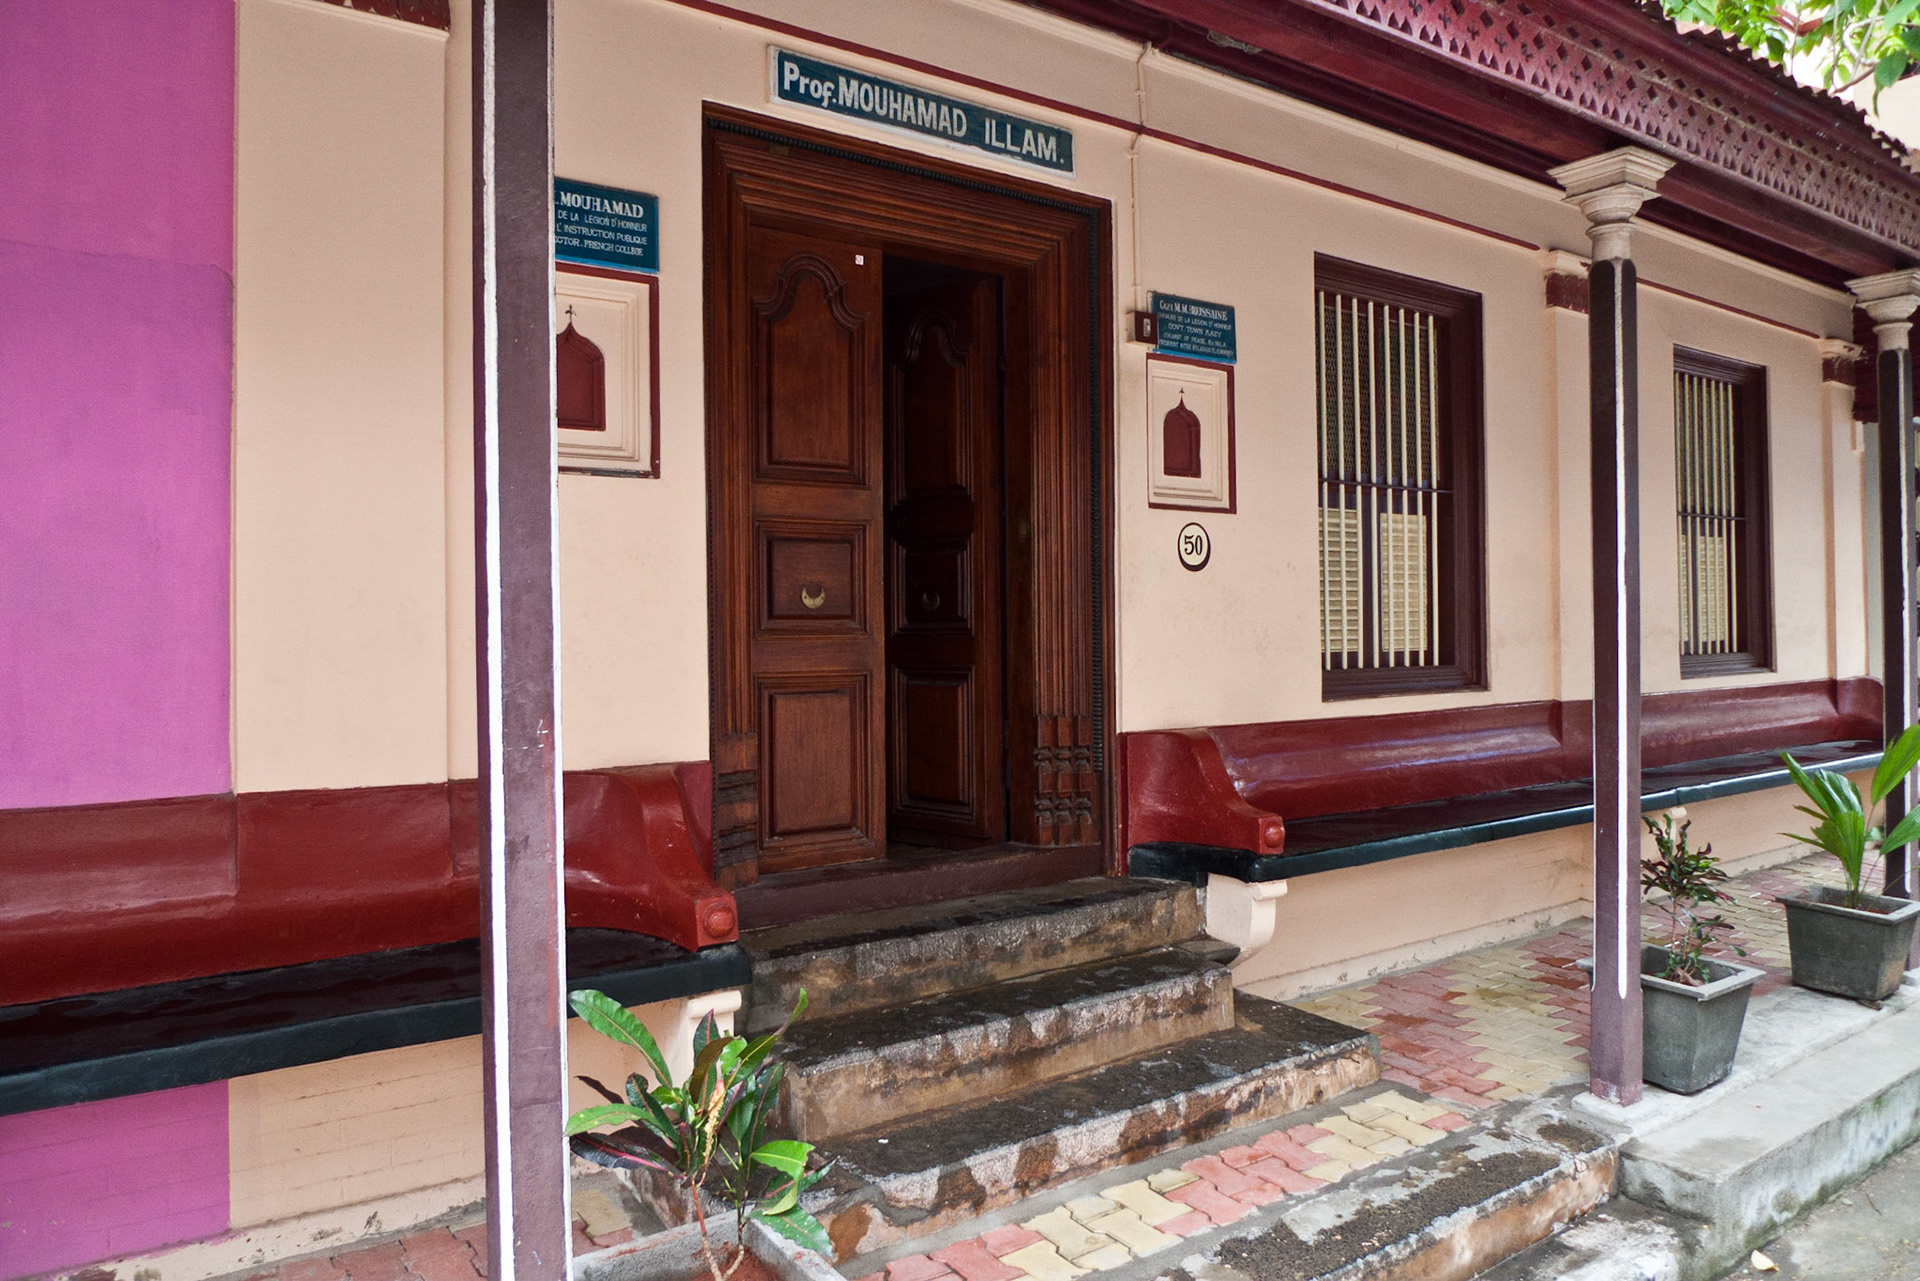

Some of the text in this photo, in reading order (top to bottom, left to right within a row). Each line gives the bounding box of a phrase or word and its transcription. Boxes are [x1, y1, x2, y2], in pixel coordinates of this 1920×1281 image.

[985, 118, 1064, 164] ILLAM.
[557, 210, 568, 219] DE
[570, 212, 579, 221] LA
[584, 214, 610, 226] LEGION
[564, 225, 615, 240] INSTRUCTION
[617, 232, 648, 245] PUBLIQUE
[615, 244, 644, 256] COLLEGE
[1184, 535, 1203, 555] 50
